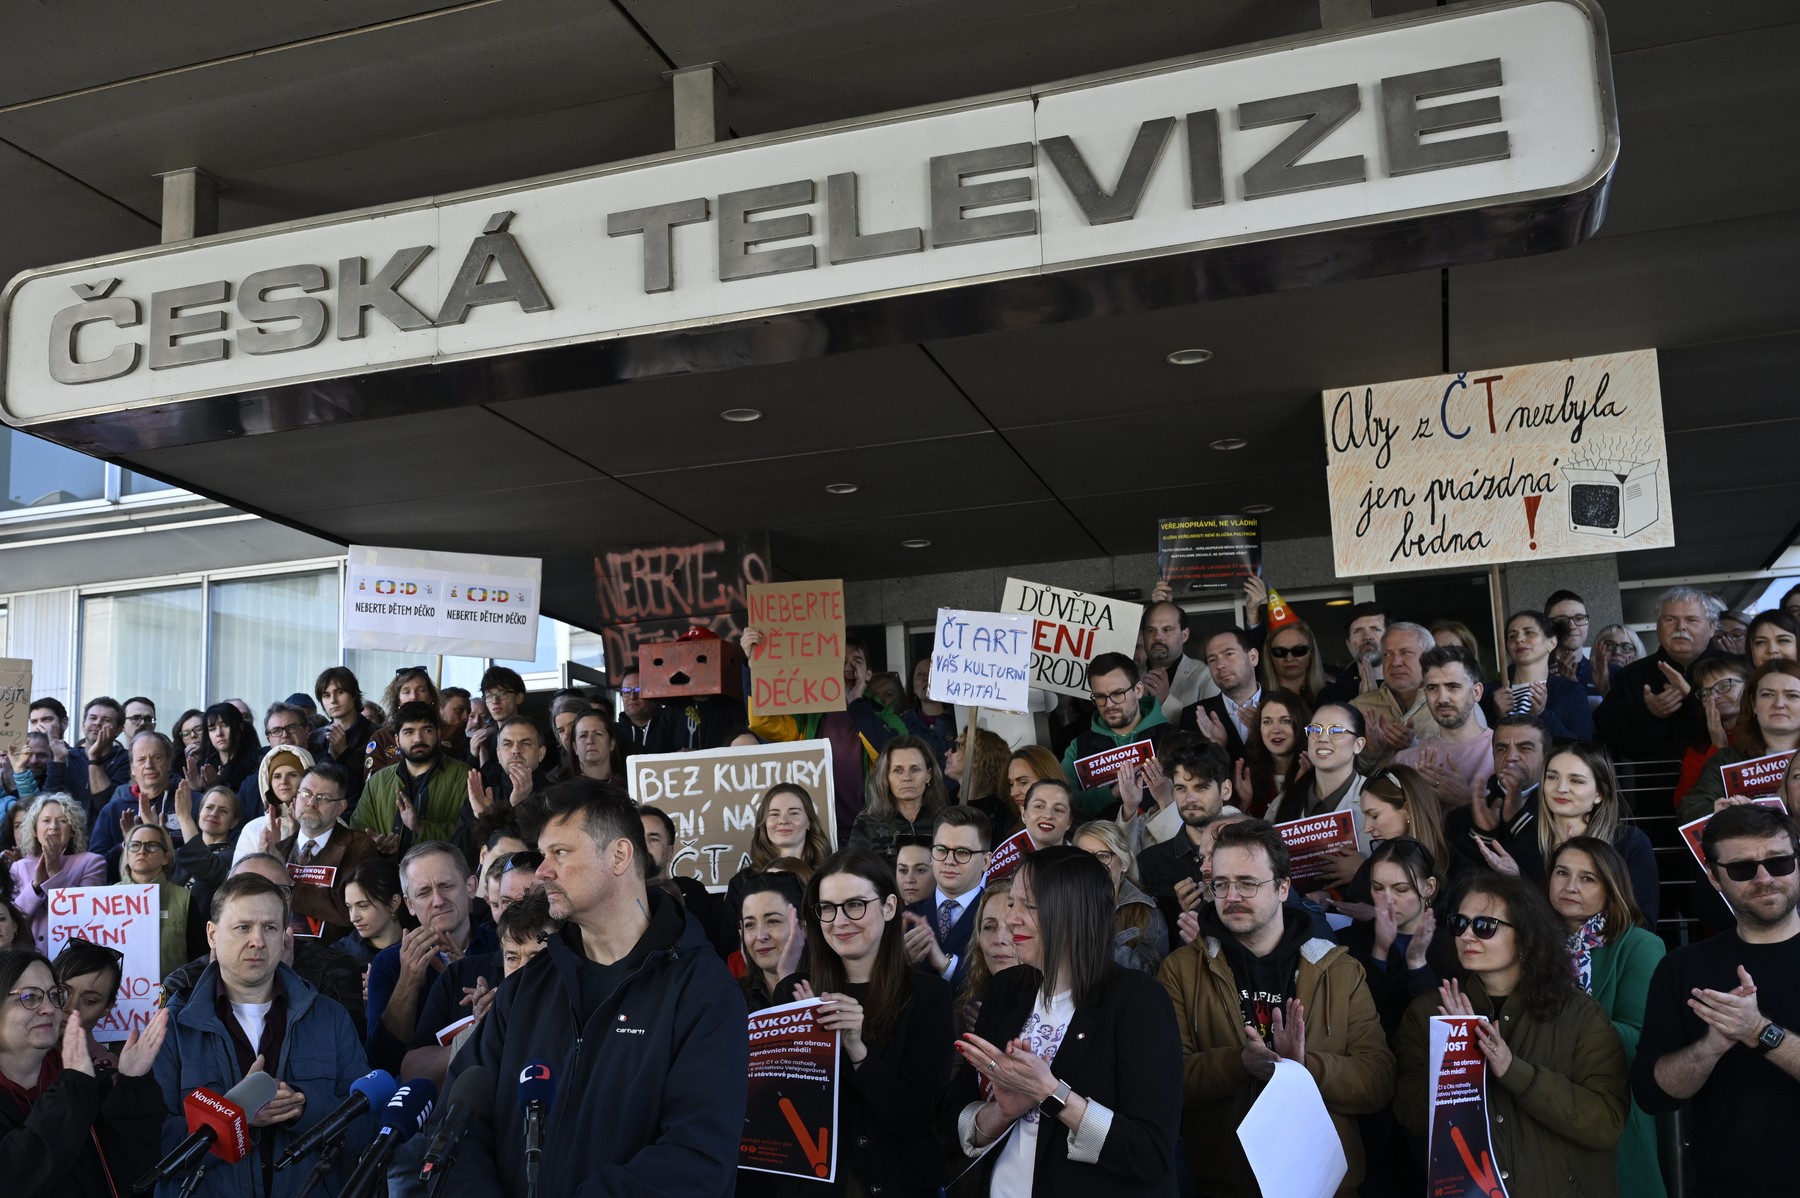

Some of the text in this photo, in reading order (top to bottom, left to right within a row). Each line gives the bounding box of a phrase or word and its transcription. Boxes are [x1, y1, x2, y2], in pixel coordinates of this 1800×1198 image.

[49, 57, 1511, 385] ČESKÁ TELEVIZE
[1331, 371, 1627, 469] Aby z ČT nezbyla
[1356, 458, 1560, 537] jen prázdná
[1161, 520, 1217, 530] VEŘEJNOPRÁVNÍ,
[1390, 511, 1491, 562] bedna
[355, 602, 435, 618] NEBERTE DĚTEM DÉČKO
[446, 609, 527, 625] NEBERTE DĚTEM DÉČKO
[749, 591, 842, 625] NEBERTE
[1017, 585, 1114, 631] DŮVĚRA
[942, 616, 1028, 655] ČT ART
[1032, 619, 1100, 661] ENÍ
[936, 653, 959, 674] VÁŠ
[755, 667, 841, 709] DÉČKO
[1088, 747, 1139, 769] STÁVKOVÁ
[1090, 756, 1141, 777] POHOTOST
[1741, 758, 1789, 778] STÁVKO
[639, 757, 826, 803] BEZ KULTURY
[1743, 771, 1785, 787] POHOTO
[1281, 817, 1337, 838] STÁVKOVÁ
[669, 838, 734, 885] ČT
[985, 851, 1020, 877] OTOVOST
[991, 841, 1017, 864] KOVÁ
[1289, 850, 1325, 862] eřejnoprávních
[294, 867, 326, 875] STÁVKOVÁ
[50, 885, 154, 917] ČT NENÍ
[51, 918, 134, 945] STÁTNÍ
[748, 1008, 814, 1031] ÁVKOVÁ
[749, 1024, 814, 1041] OTOVOST
[804, 1040, 831, 1048] obranu
[750, 1047, 787, 1057] oprávních
[754, 1070, 786, 1078] stávkové
[787, 1072, 830, 1083] pohotovosti.
[191, 1090, 236, 1118] Novinky.cz
